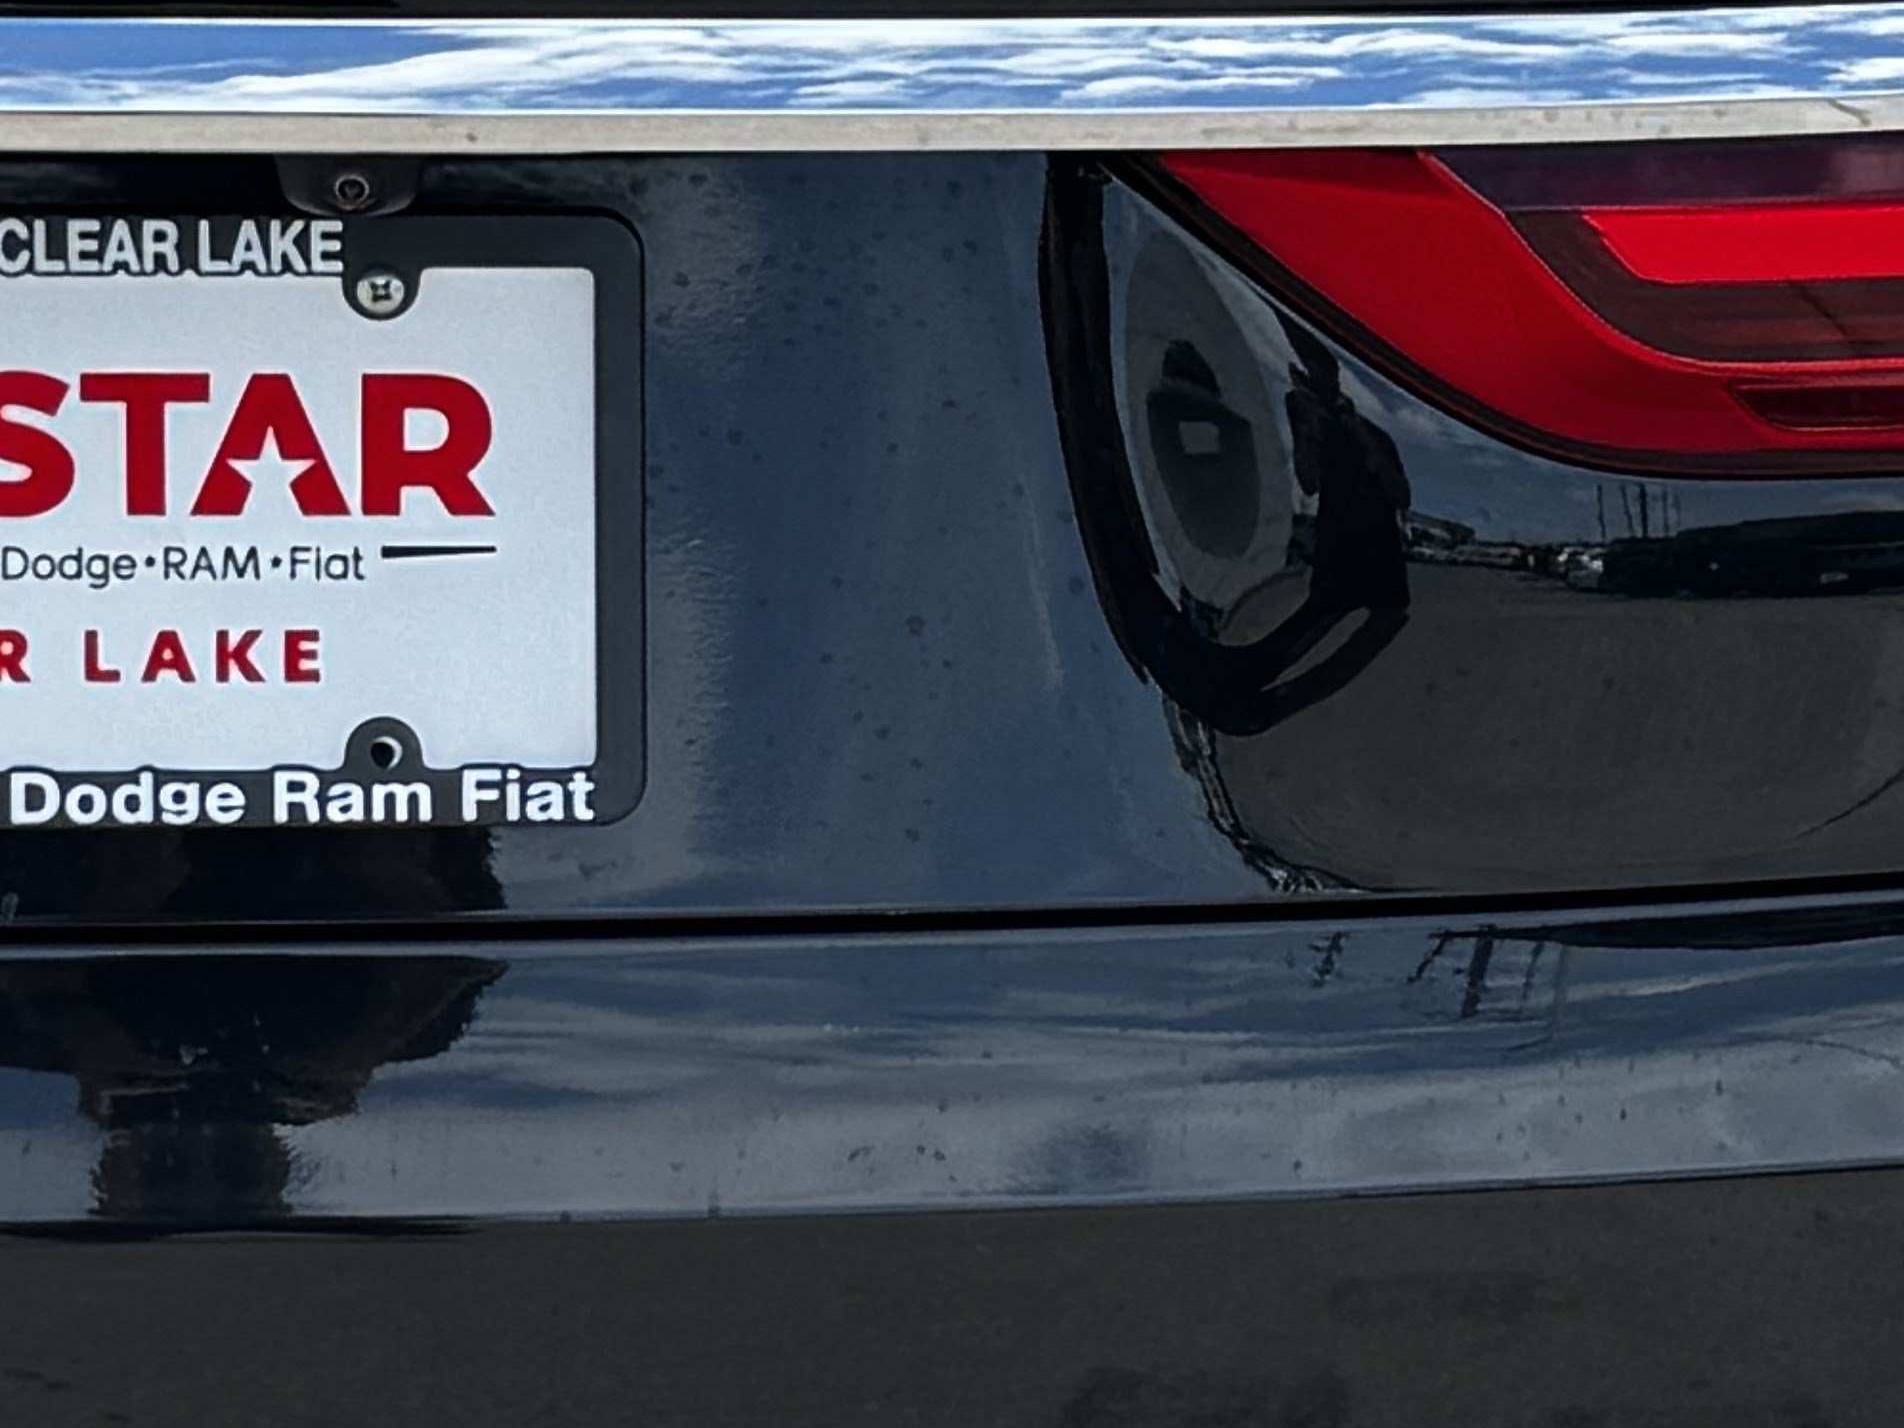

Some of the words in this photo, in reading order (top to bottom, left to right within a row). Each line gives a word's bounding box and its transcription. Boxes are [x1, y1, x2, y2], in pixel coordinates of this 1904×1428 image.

[197, 218, 345, 275] LAKE
[0, 544, 139, 591] Dodge
[162, 544, 262, 582] RAM
[288, 544, 366, 582] Fiat
[83, 628, 324, 683] LAKE
[8, 769, 247, 828] Dodge
[272, 768, 434, 826] Ram
[460, 767, 596, 824] Fiat
